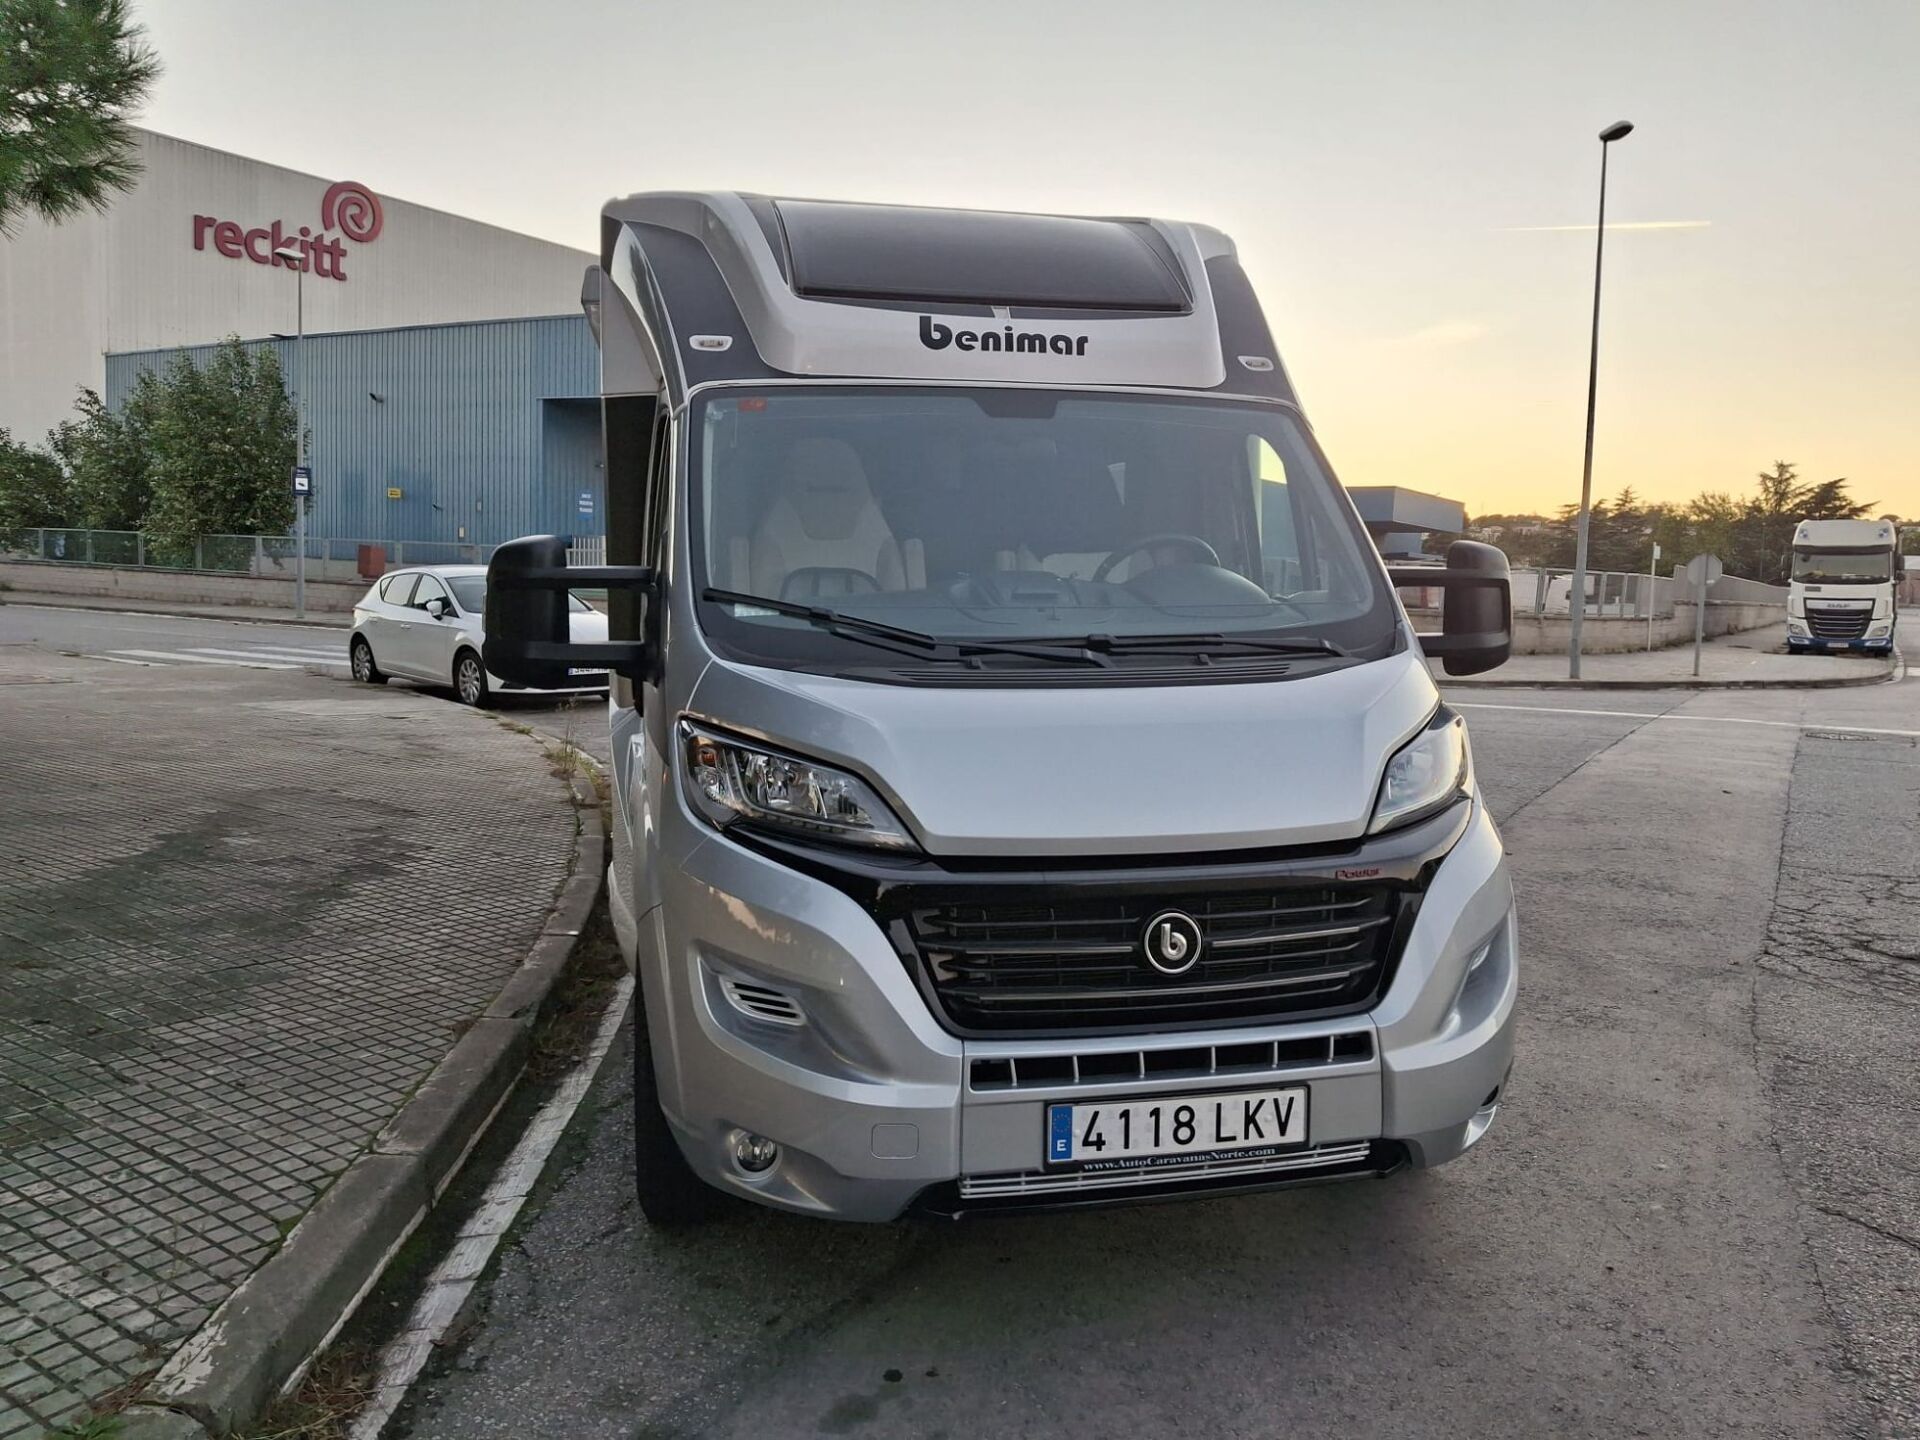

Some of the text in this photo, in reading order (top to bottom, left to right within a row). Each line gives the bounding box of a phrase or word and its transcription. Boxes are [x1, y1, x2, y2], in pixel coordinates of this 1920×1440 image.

[193, 214, 348, 282] reckitt
[919, 315, 1089, 357] benimar
[1081, 1096, 1295, 1152] 4118 LKV
[1056, 1139, 1067, 1152] E
[1083, 1147, 1277, 1171] www.AutoCaravanasNorte.com
